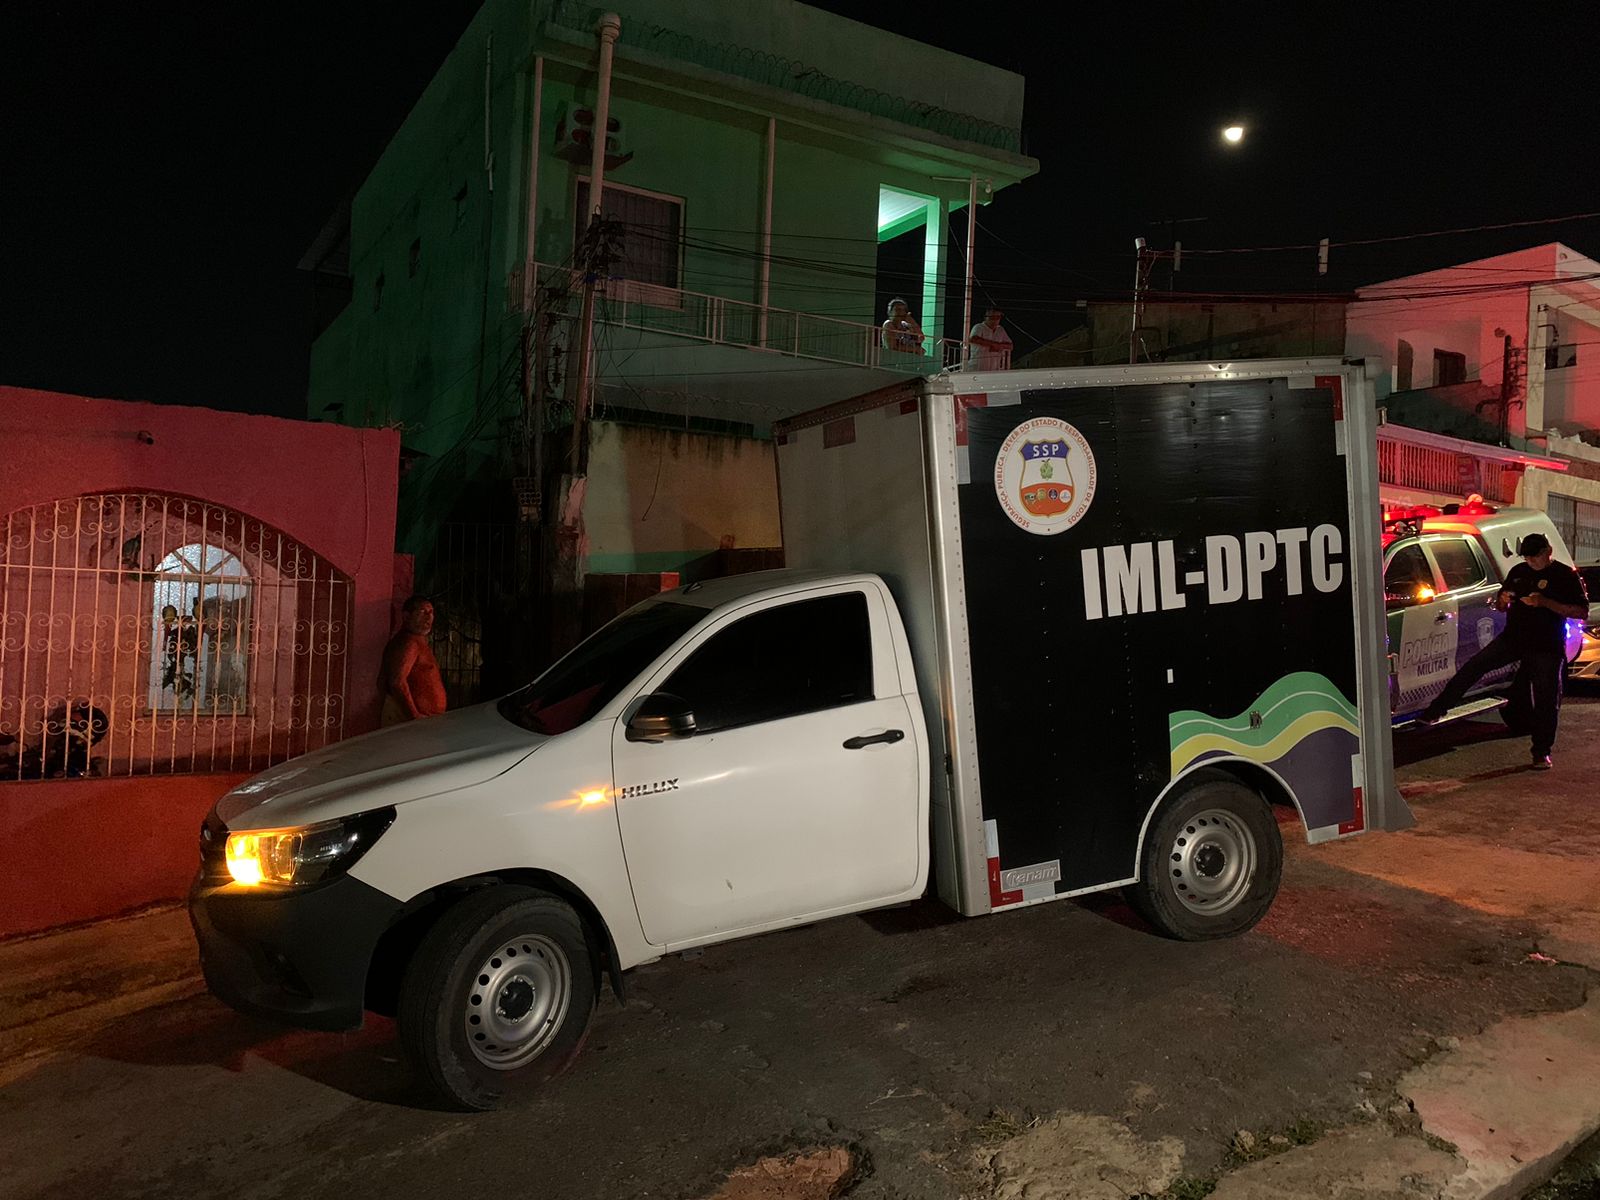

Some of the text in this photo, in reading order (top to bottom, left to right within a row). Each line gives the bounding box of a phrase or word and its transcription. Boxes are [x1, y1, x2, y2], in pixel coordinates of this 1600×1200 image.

[1020, 423, 1030, 433] DO
[1031, 419, 1058, 427] ESTADO
[1033, 444, 1059, 457] SSP
[1085, 492, 1092, 502] DE
[1068, 503, 1088, 524] TODOS
[1081, 524, 1343, 620] IML-DPTC
[1417, 658, 1449, 677] MILITAR
[621, 778, 679, 799] HILUX
